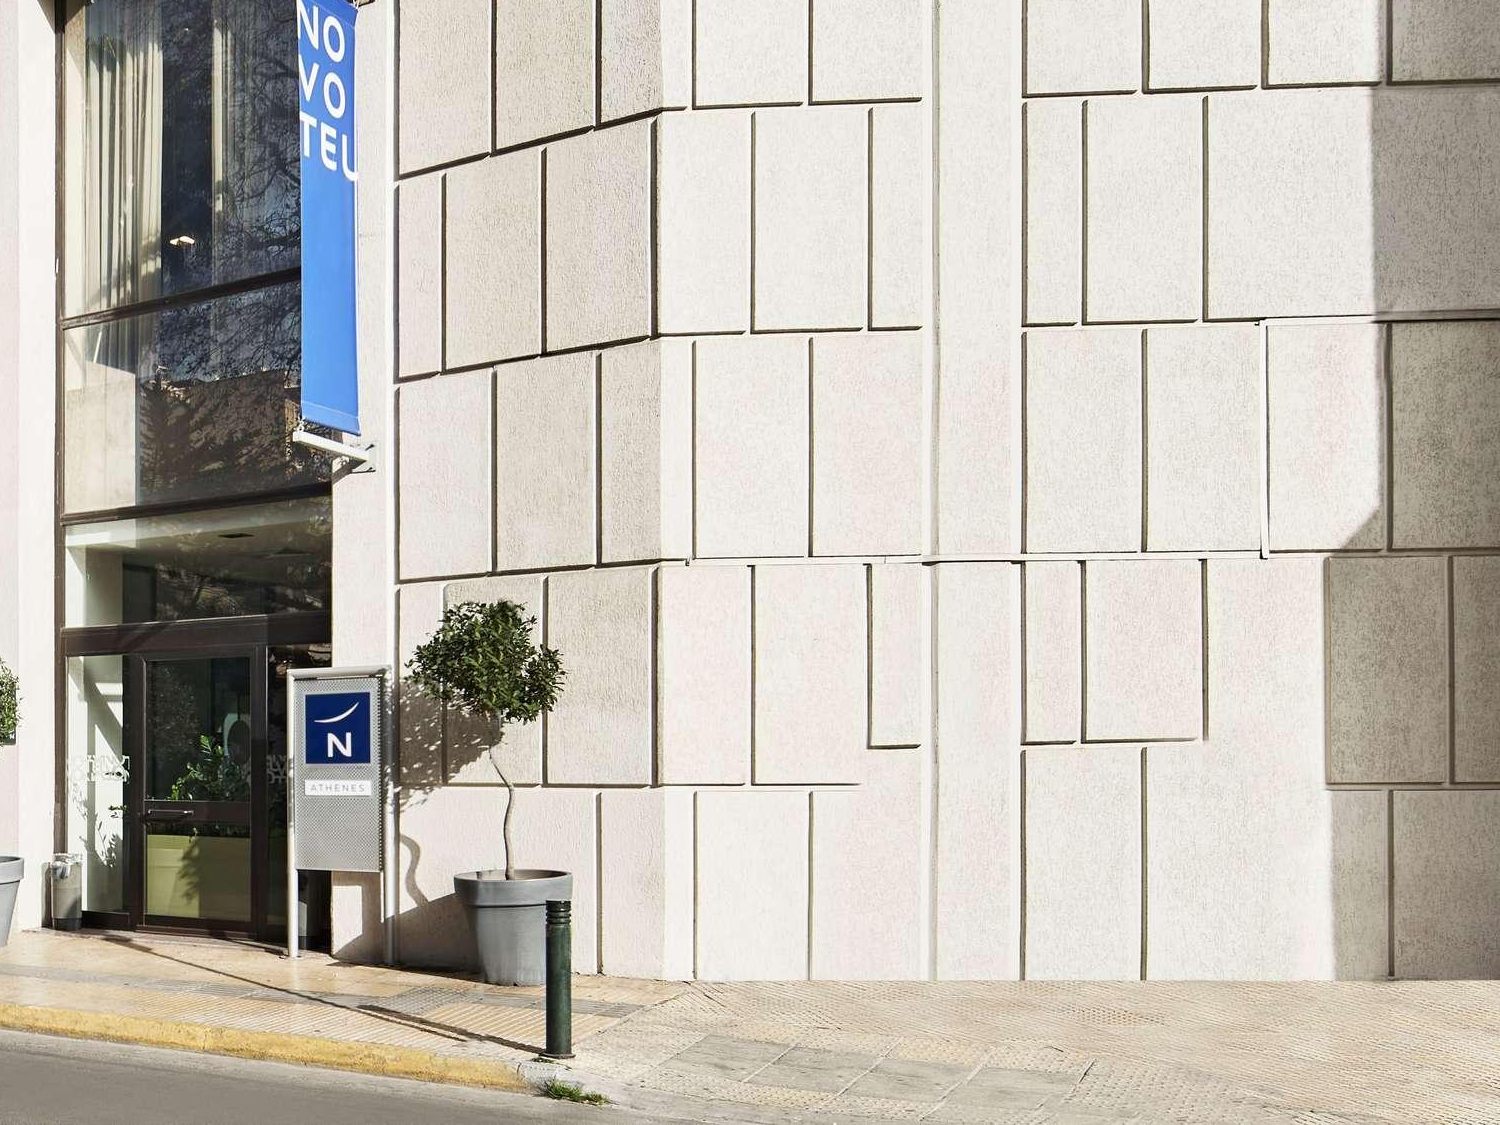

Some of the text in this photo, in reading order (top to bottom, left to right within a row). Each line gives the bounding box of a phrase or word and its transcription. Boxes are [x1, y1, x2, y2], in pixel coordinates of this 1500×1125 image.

[299, 55, 346, 119] VO
[299, 111, 358, 182] TEL
[327, 731, 352, 758] N
[310, 783, 365, 792] ATHENES
